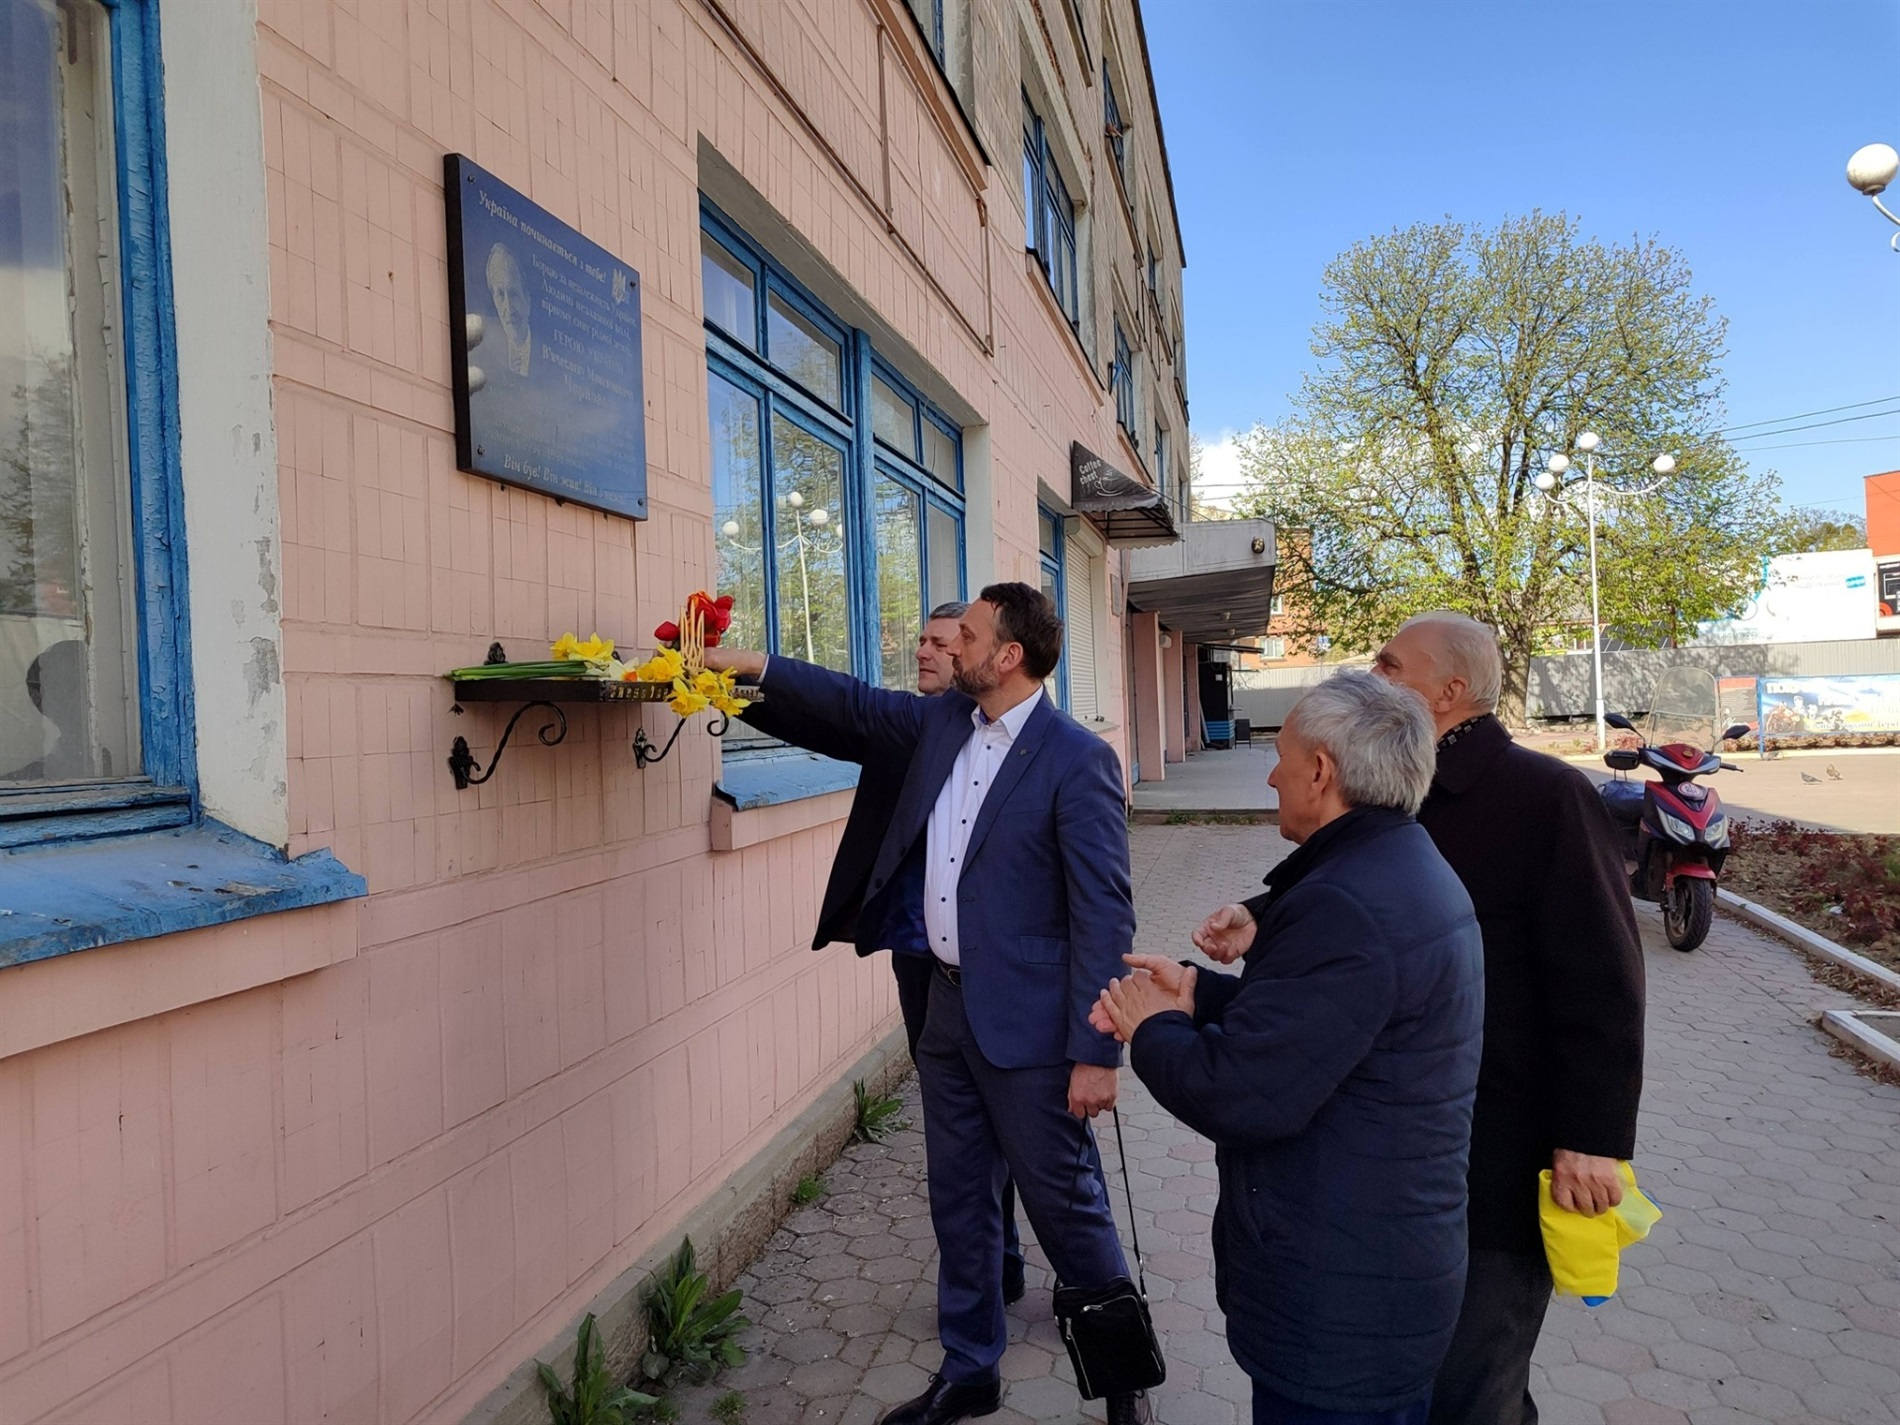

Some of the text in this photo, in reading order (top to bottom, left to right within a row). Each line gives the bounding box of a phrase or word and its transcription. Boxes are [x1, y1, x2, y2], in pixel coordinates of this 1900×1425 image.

[479, 189, 608, 285] Україна починається з тебе!
[559, 274, 568, 286] за
[553, 330, 585, 356] ГЕРОЮ
[503, 454, 521, 473] Він
[523, 461, 541, 480] був!
[543, 467, 559, 484] Він
[584, 481, 598, 496] Він
[1079, 459, 1102, 474] Coffee
[1079, 471, 1098, 485] chest
